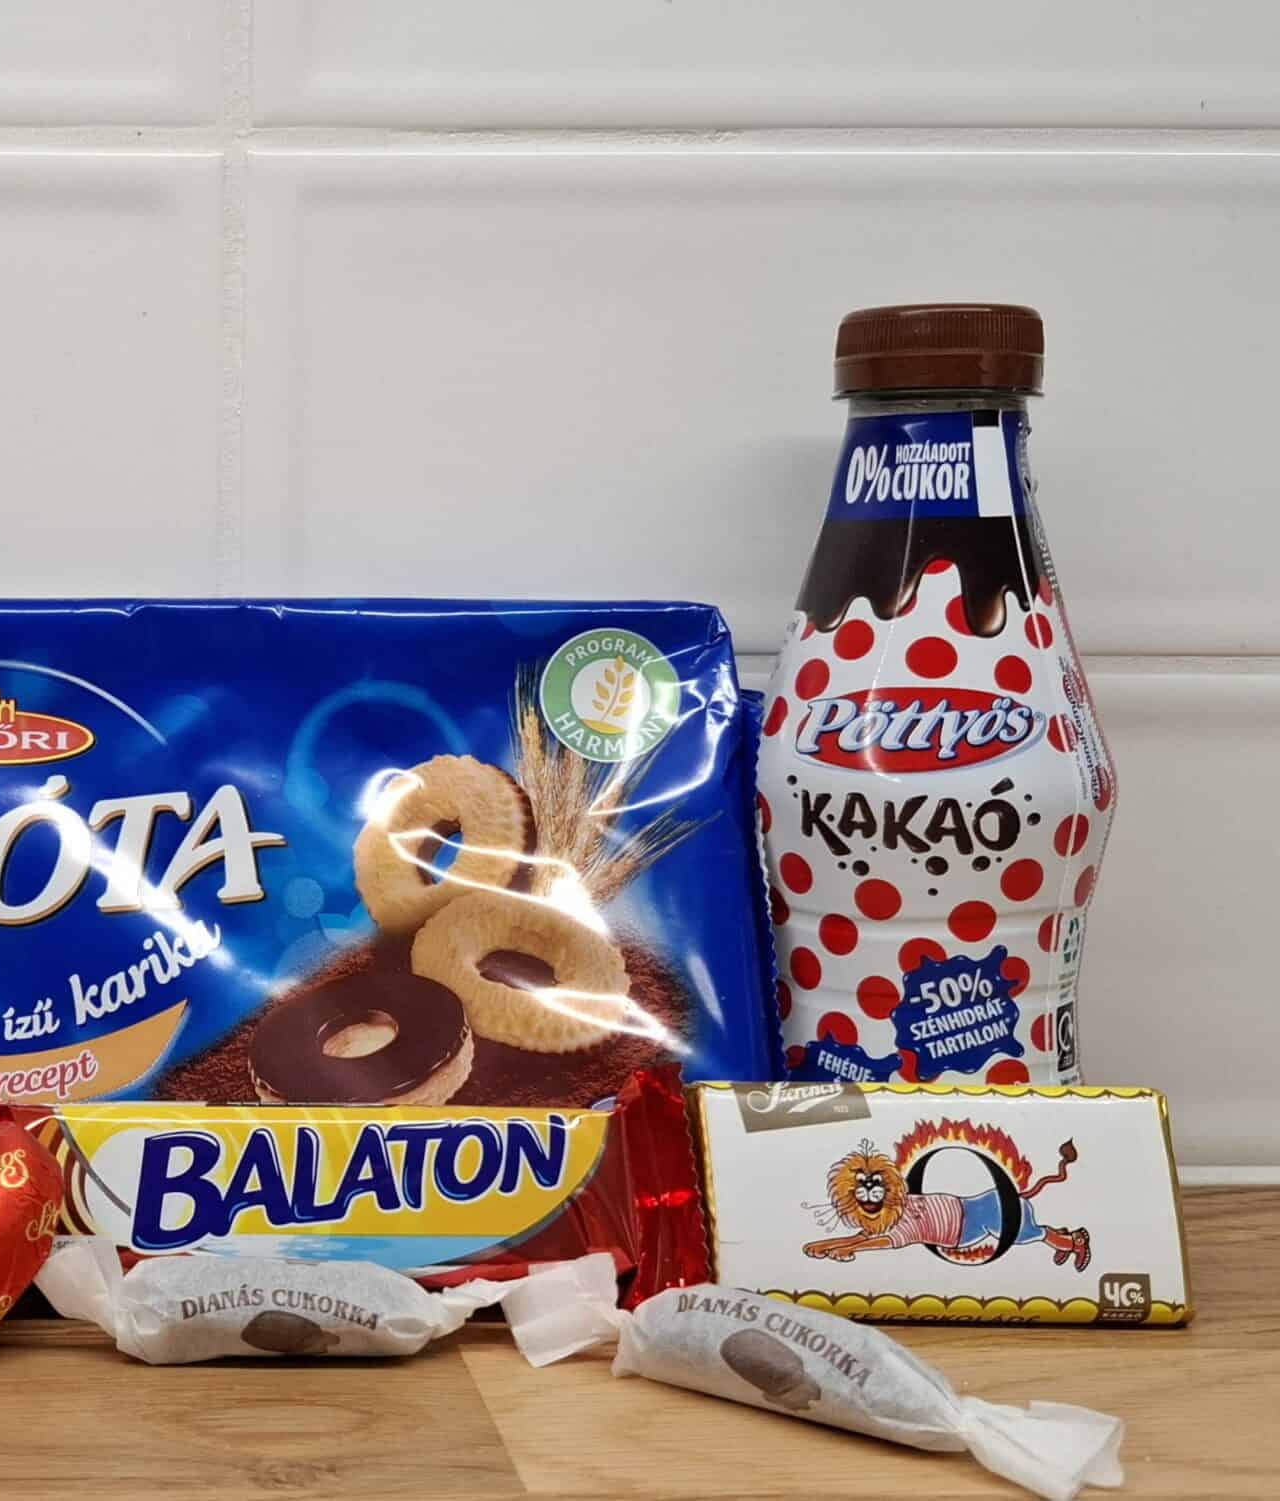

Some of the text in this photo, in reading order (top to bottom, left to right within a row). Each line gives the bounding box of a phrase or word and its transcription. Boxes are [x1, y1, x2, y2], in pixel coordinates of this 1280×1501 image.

[846, 440, 971, 504] 0% HOZZÁADOTT
[892, 463, 970, 500] CUKOR
[565, 638, 656, 666] PROGRAM
[795, 697, 1034, 760] Pöttyös
[801, 777, 1021, 856] KAKAÓ
[909, 968, 993, 1013] -50%
[910, 998, 1007, 1040] SZÉNHIDRÁT-
[131, 1114, 570, 1253] BALATON
[180, 1284, 380, 1331] DIANÁS CUKORKA
[676, 1293, 873, 1388] DIANÁS CUKORKA
